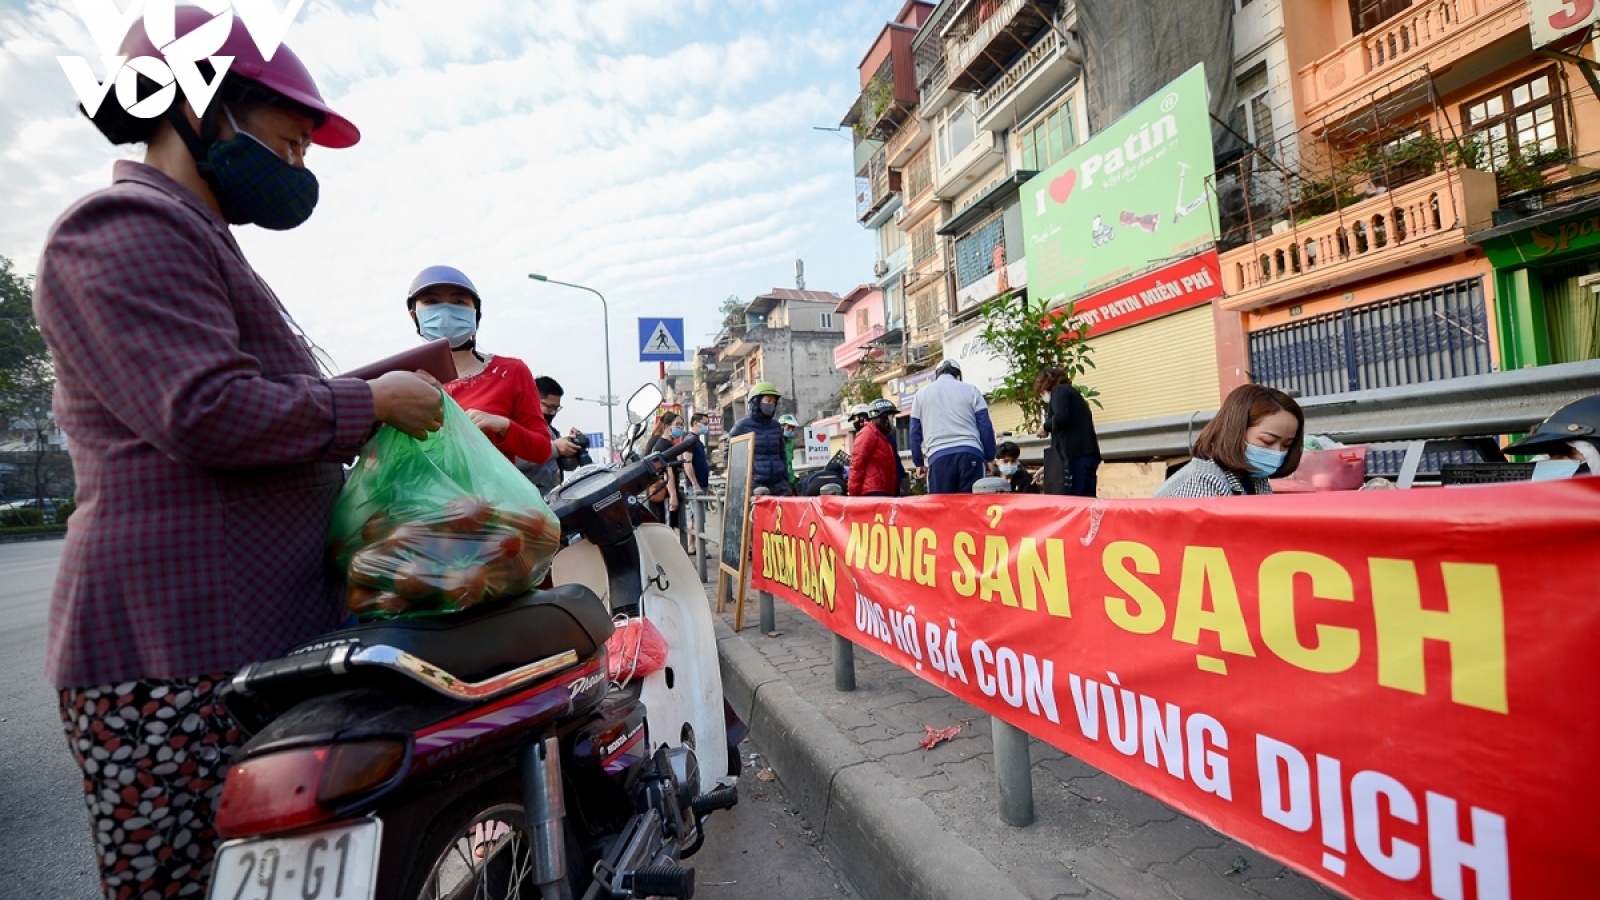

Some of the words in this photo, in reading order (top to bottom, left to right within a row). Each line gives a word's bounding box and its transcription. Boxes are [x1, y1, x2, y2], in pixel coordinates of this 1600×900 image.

[1035, 188, 1046, 216] I
[1080, 114, 1178, 190] Patin
[1100, 294, 1142, 320] PATIN
[1180, 266, 1214, 293] PHÍ
[799, 521, 837, 613] BÁN
[845, 513, 937, 588] NÔNG
[951, 505, 1072, 618] SẢN
[1101, 539, 1509, 715] SẠCH
[888, 604, 923, 671] HỘ
[925, 617, 969, 685] BÀ
[970, 639, 1061, 725] CON
[1069, 670, 1233, 802] VÙNG
[1255, 733, 1512, 900] DỊCH
[232, 833, 351, 900] 29-G1
